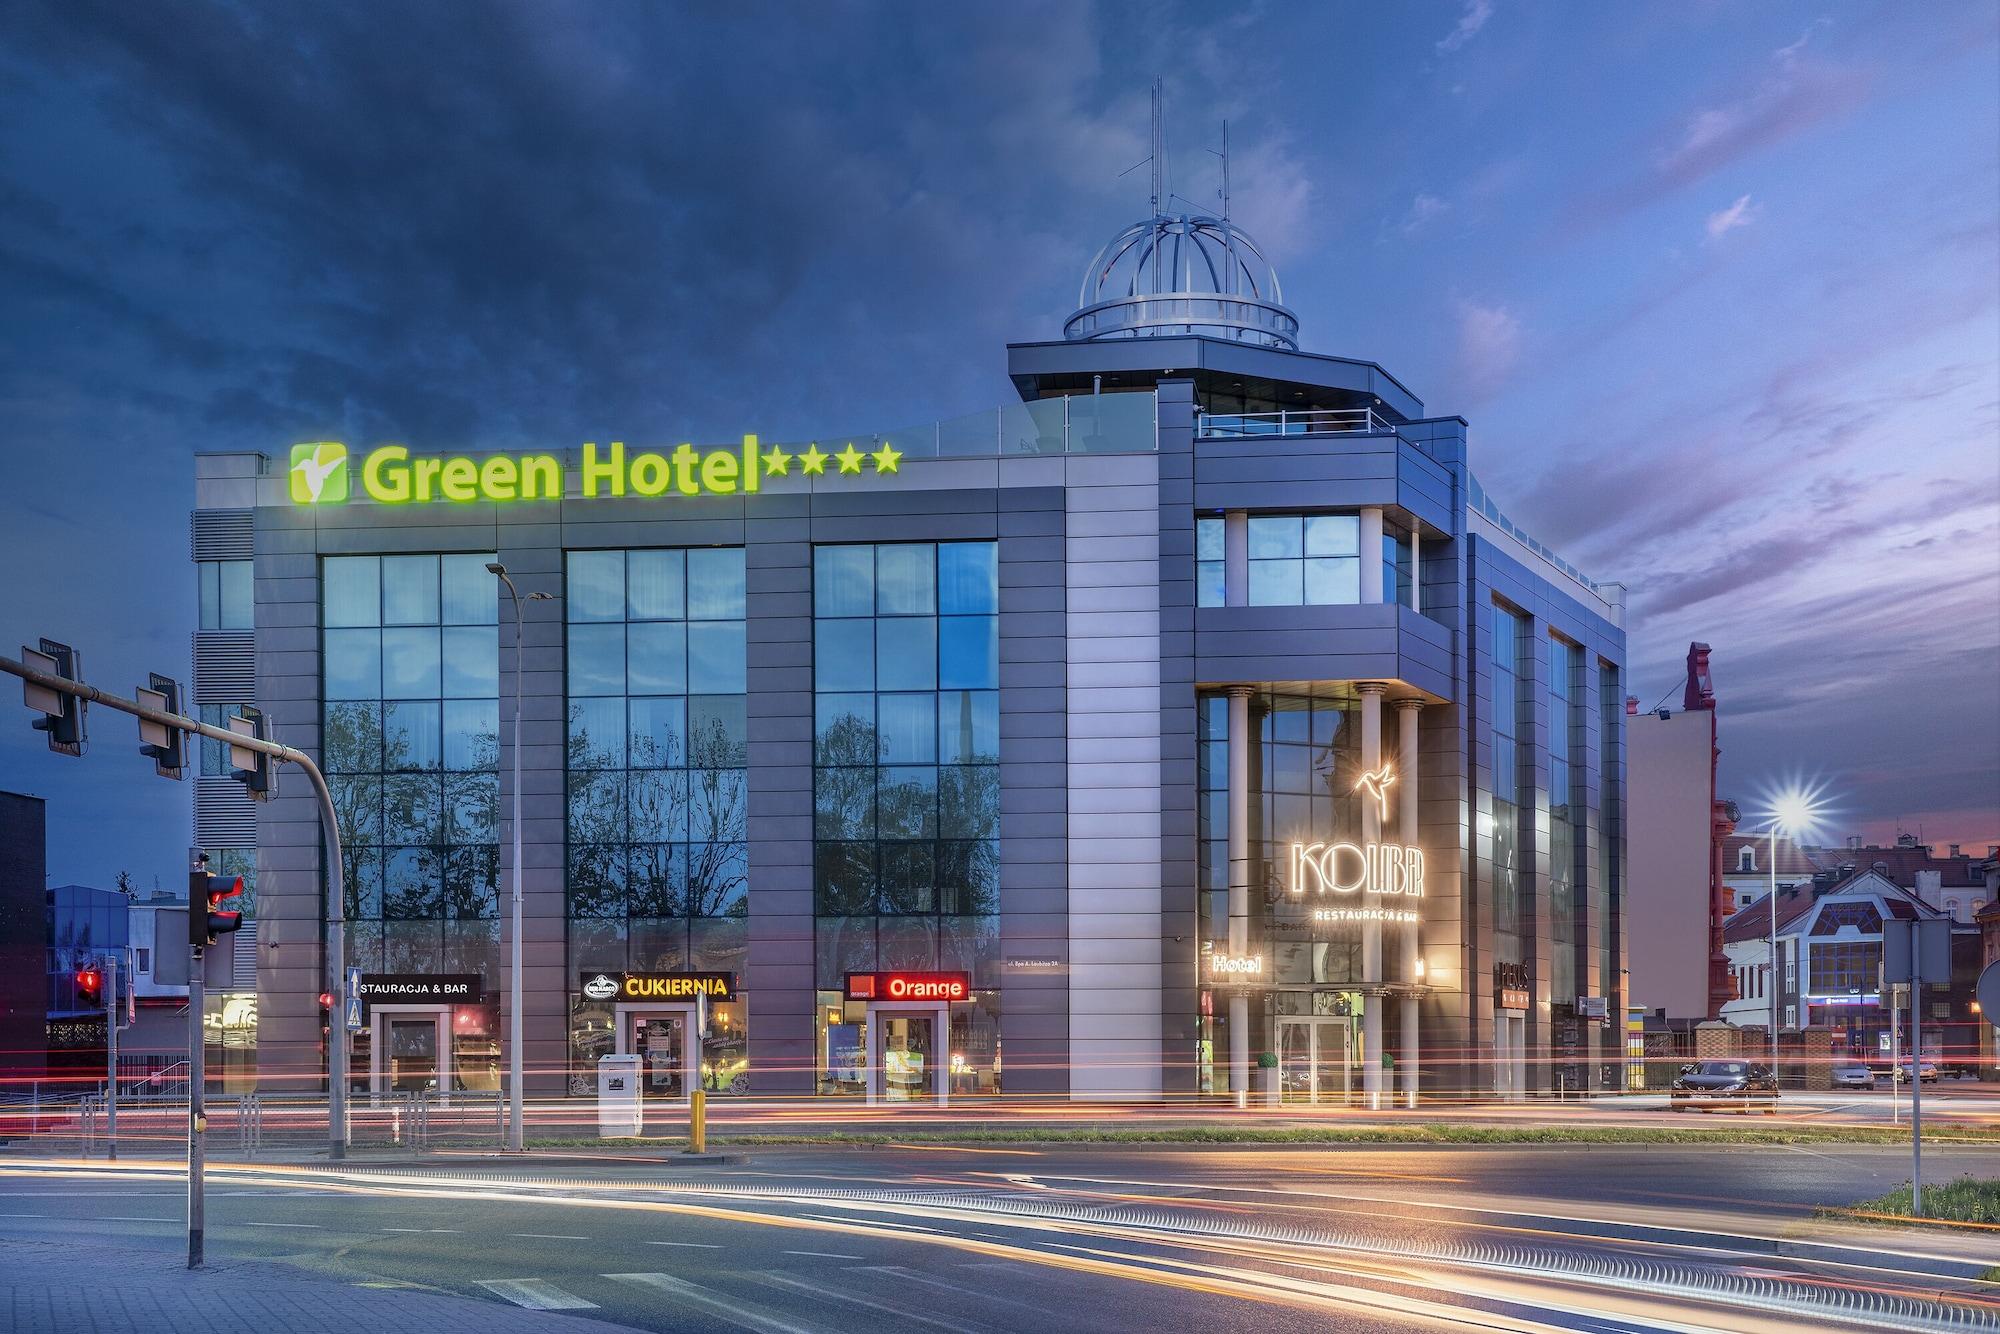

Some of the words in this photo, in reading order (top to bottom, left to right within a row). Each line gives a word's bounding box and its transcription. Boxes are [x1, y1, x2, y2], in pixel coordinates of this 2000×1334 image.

[362, 446, 561, 502] Green
[581, 434, 758, 498] Hotel
[1291, 842, 1425, 897] KOLIBER
[1314, 909, 1394, 921] RESTAURACJA
[1212, 954, 1263, 972] Hotel
[360, 984, 429, 994] STAURACJA
[432, 984, 441, 994] &
[444, 984, 468, 994] BAR
[625, 978, 727, 996] CUKIERNIA
[889, 979, 962, 999] Orange
